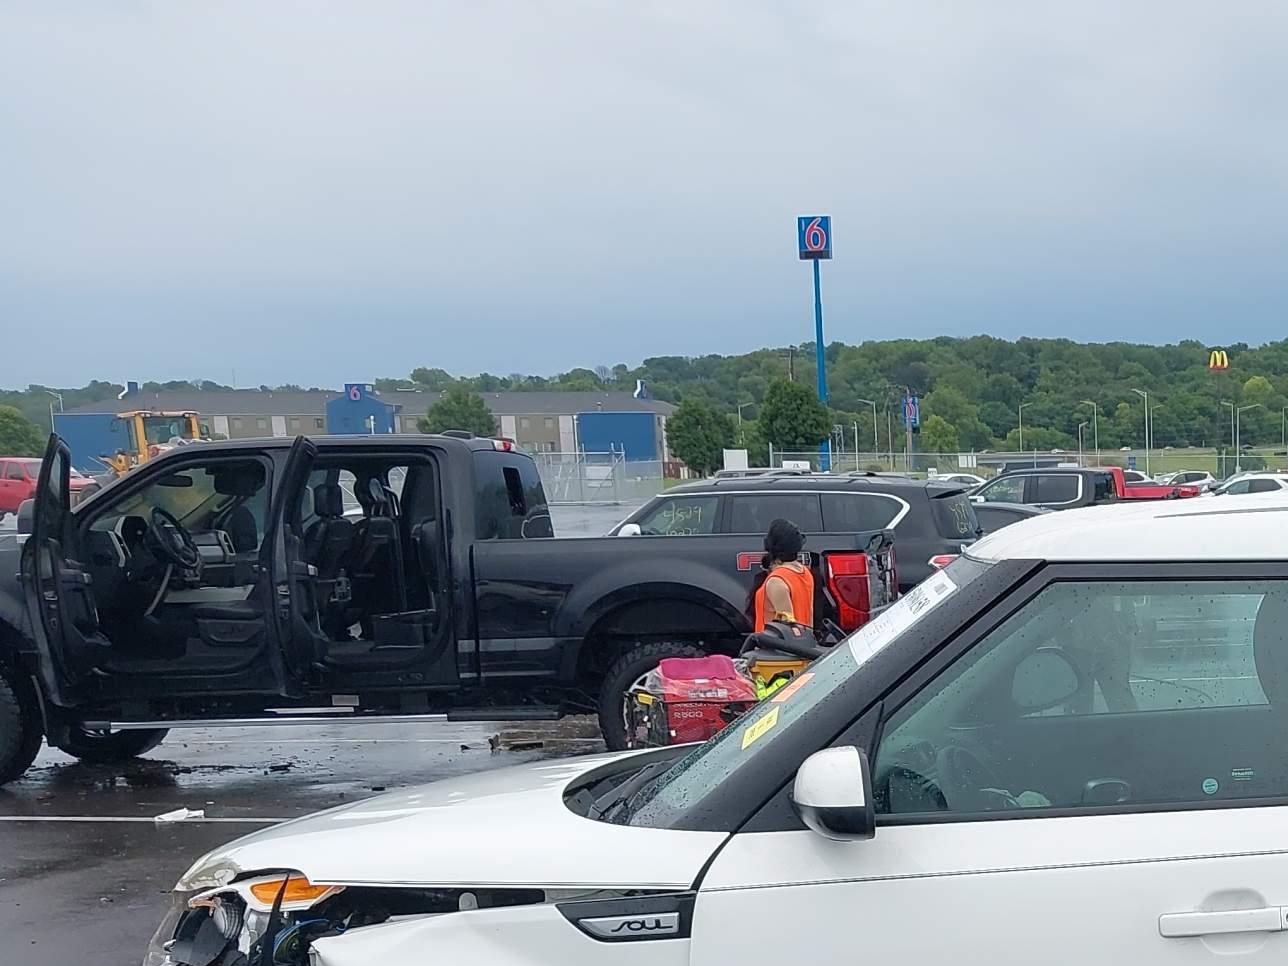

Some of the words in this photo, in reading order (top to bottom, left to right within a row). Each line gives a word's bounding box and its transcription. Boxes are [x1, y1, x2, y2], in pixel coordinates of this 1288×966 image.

[805, 217, 826, 251] 6
[350, 386, 361, 401] 6
[611, 919, 673, 932] SOUL
